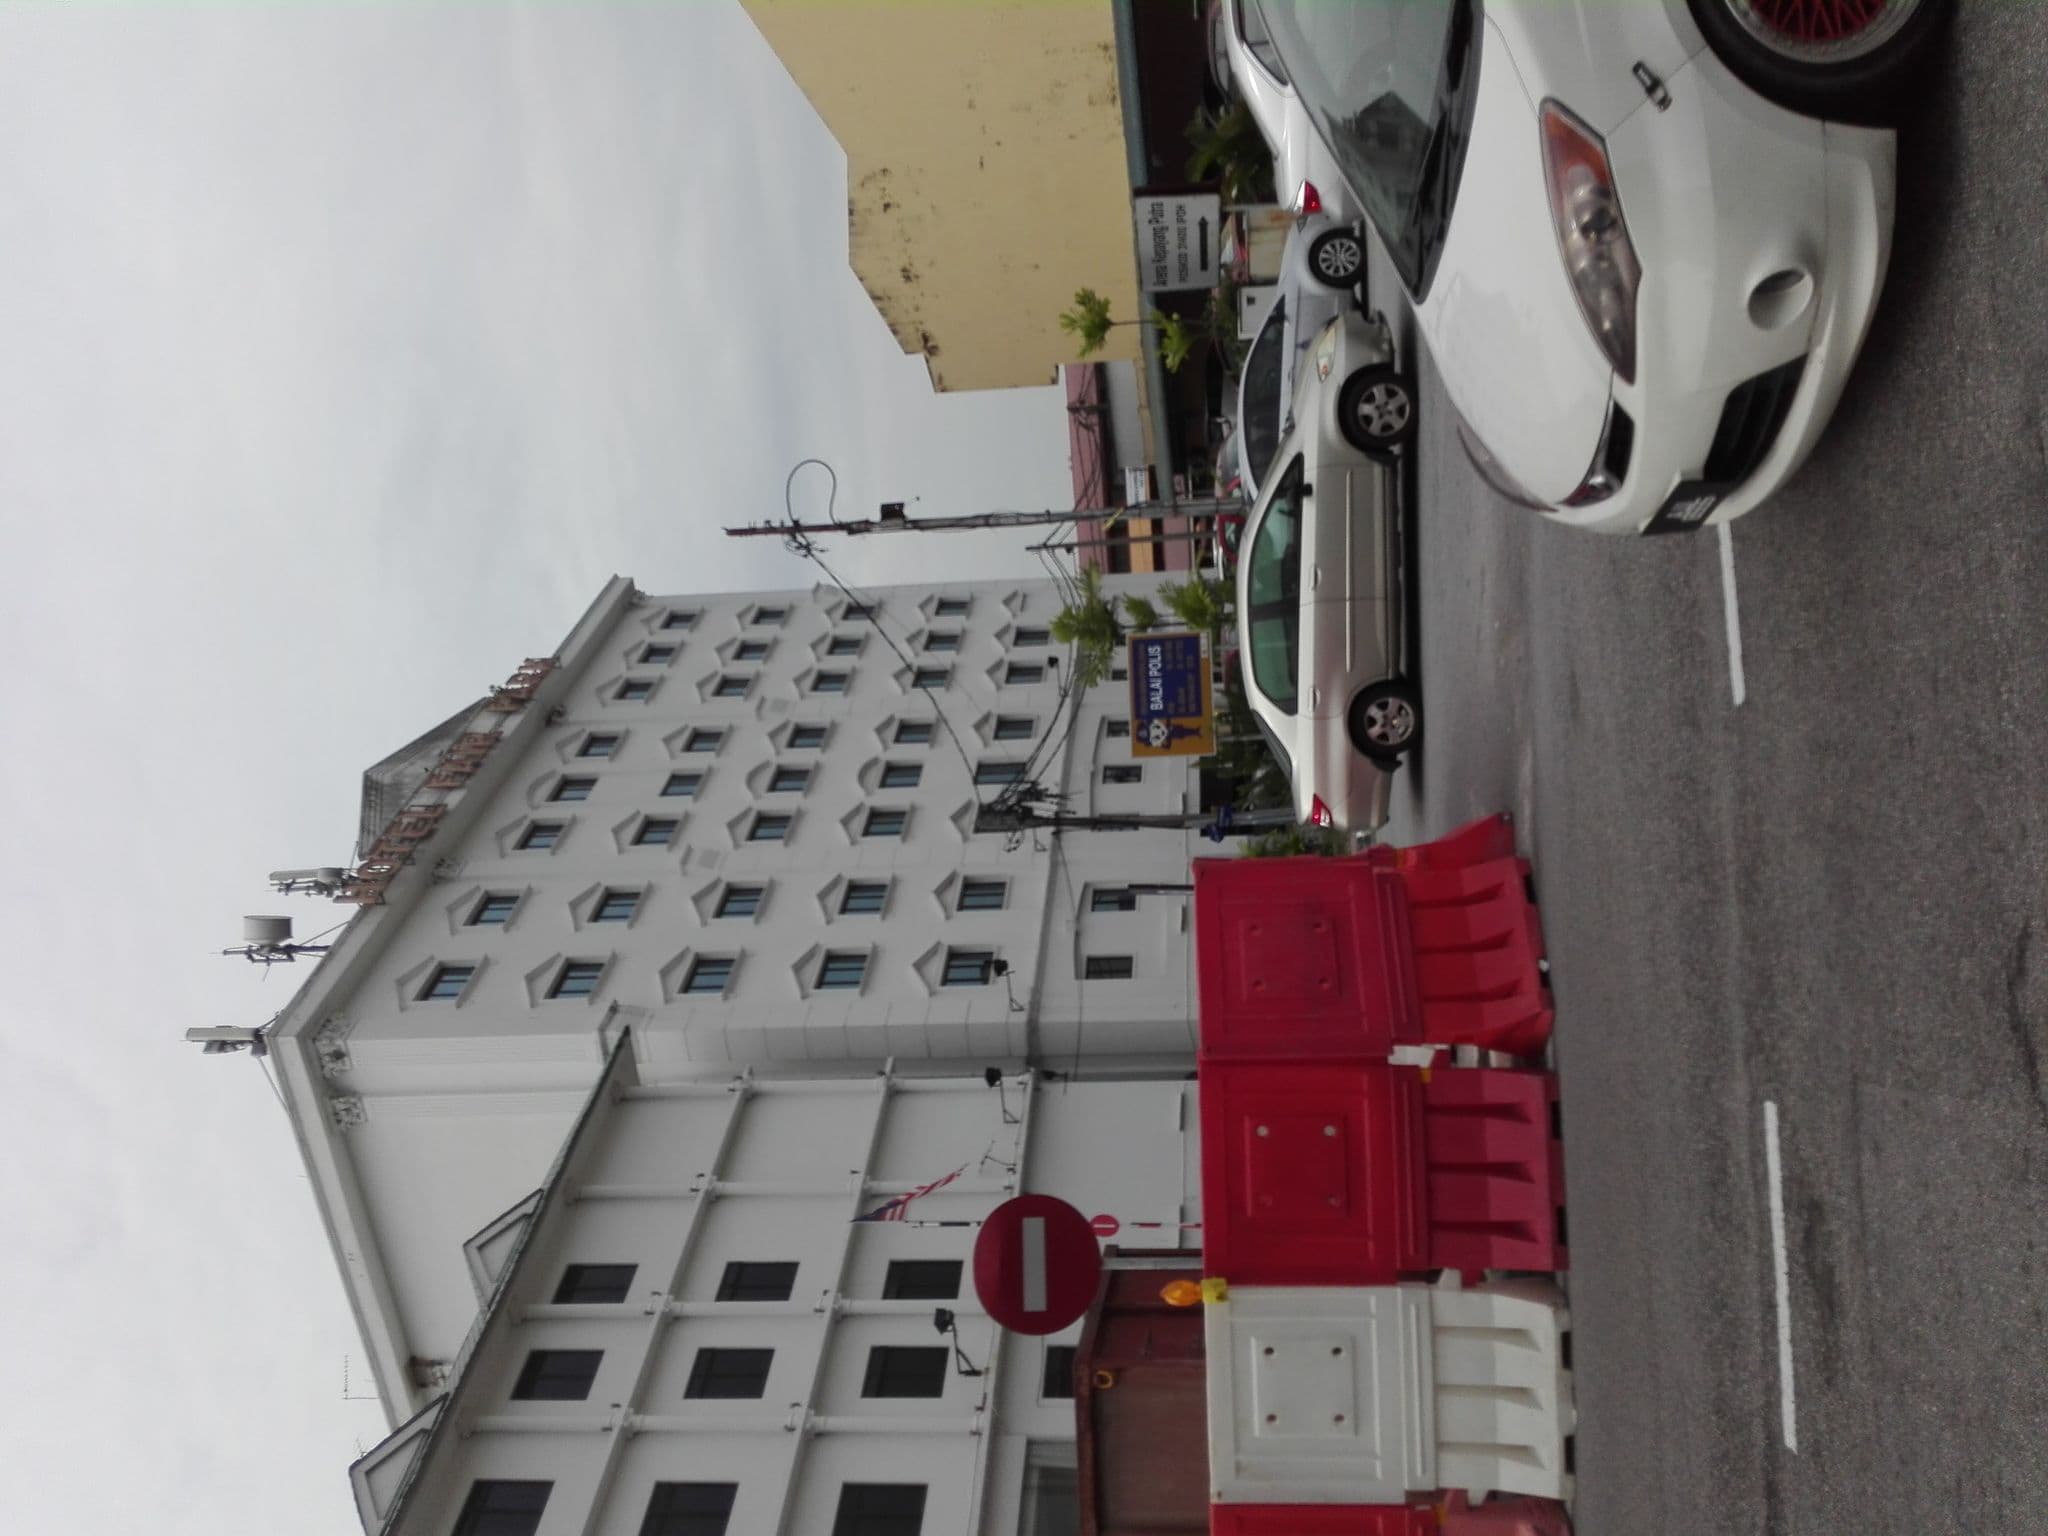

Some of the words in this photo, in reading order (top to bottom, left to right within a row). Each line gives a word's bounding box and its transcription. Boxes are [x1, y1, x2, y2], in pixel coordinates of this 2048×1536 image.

[1147, 202, 1164, 225] Putra
[1147, 645, 1162, 677] POLIS
[1149, 678, 1164, 711] BALAI
[333, 804, 447, 904] HOTEL
